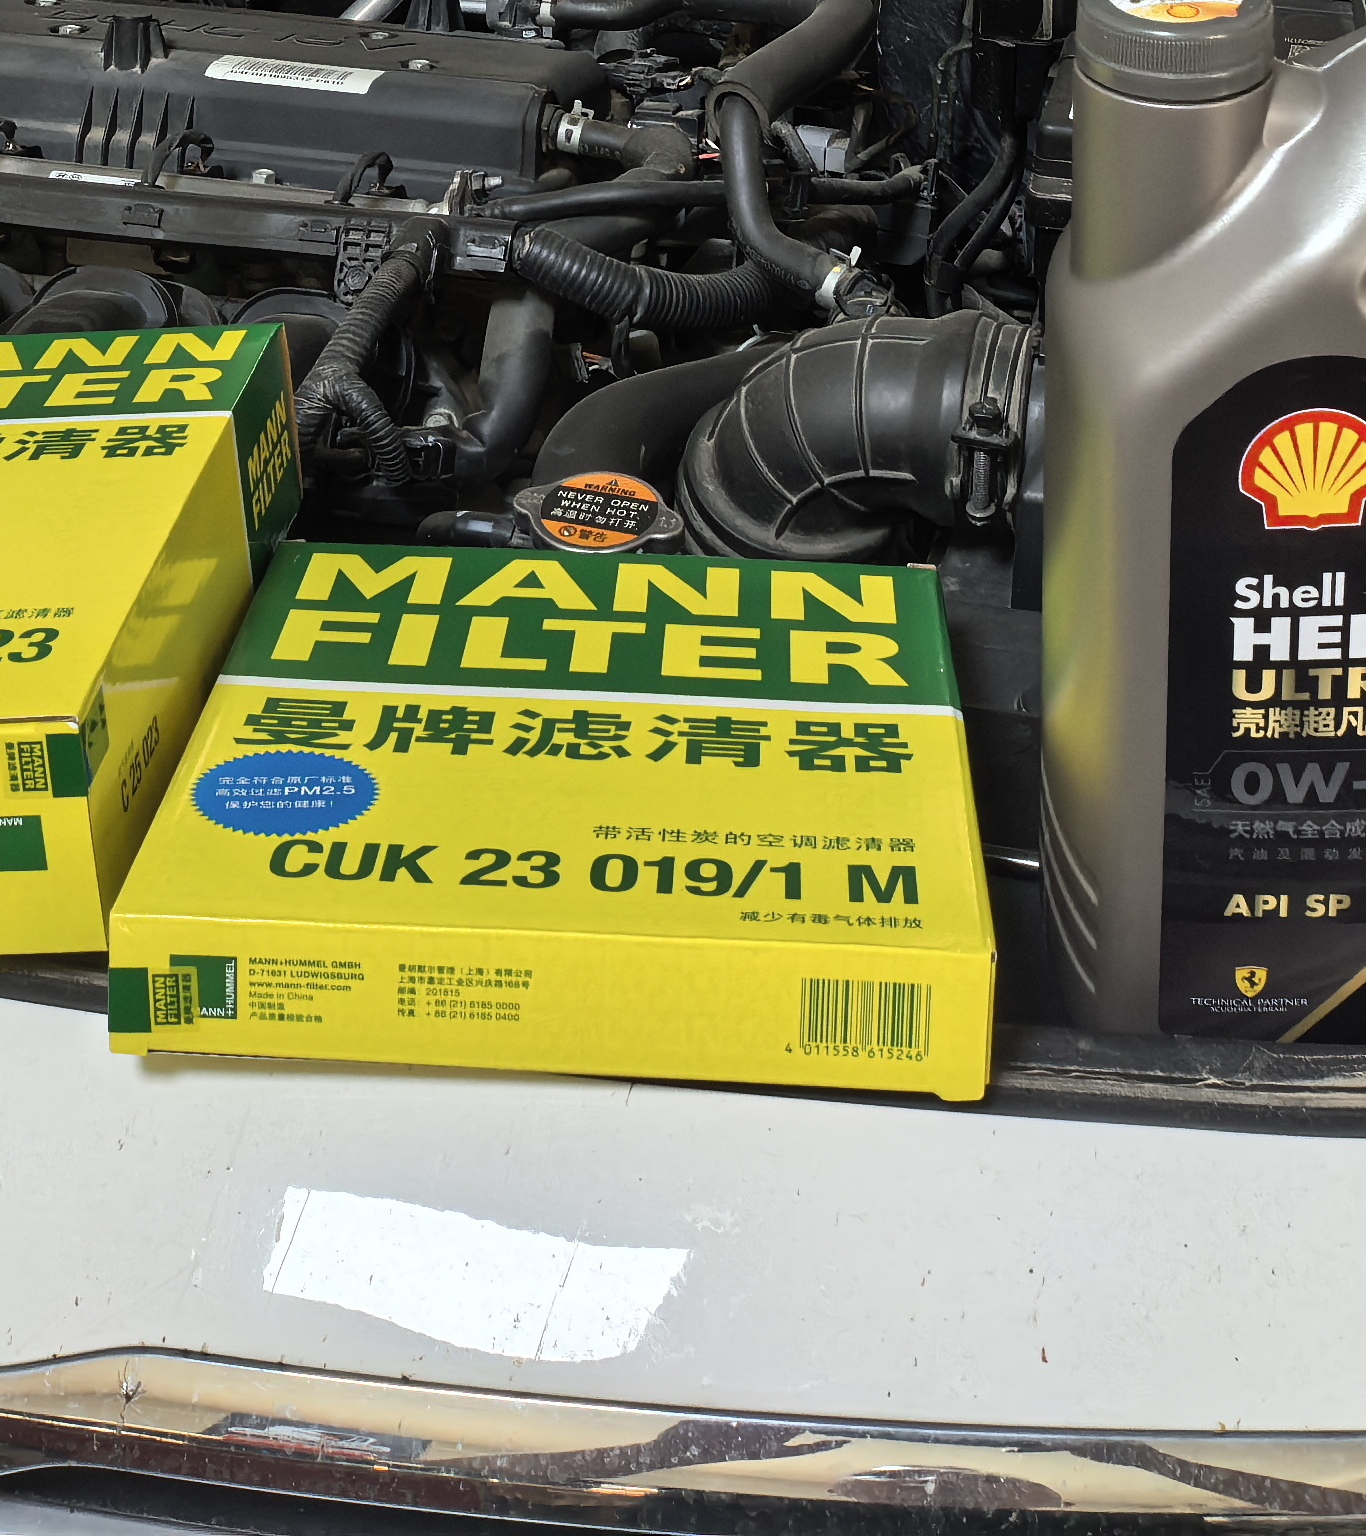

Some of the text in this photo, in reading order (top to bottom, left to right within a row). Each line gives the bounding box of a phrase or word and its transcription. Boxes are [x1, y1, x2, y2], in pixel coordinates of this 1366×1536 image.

[246, 391, 287, 490] MANN
[252, 442, 291, 532] FILTER
[557, 490, 649, 512] NEVER OPEN
[560, 500, 600, 512] WHEN
[584, 483, 637, 497] WARNING
[295, 552, 898, 625] MANN
[1234, 571, 1345, 609] Shell
[271, 608, 909, 688] FILTER
[233, 696, 913, 773] 曼牌滤清器
[20, 744, 35, 791] FILTER
[31, 744, 46, 791] MANN
[593, 825, 917, 853] 带活性炭的空调滤清器
[268, 838, 920, 905] CUK 23 019/1 M
[739, 910, 924, 930] 减少有毒气体排放
[1223, 893, 1351, 918] API SP
[155, 976, 166, 1023] MANN
[167, 976, 177, 1023] FILTER
[249, 991, 313, 1001] Made in China
[1190, 997, 1308, 1006] TECHNICAL PARTNER
[785, 1042, 924, 1061] 4 011558 615246
